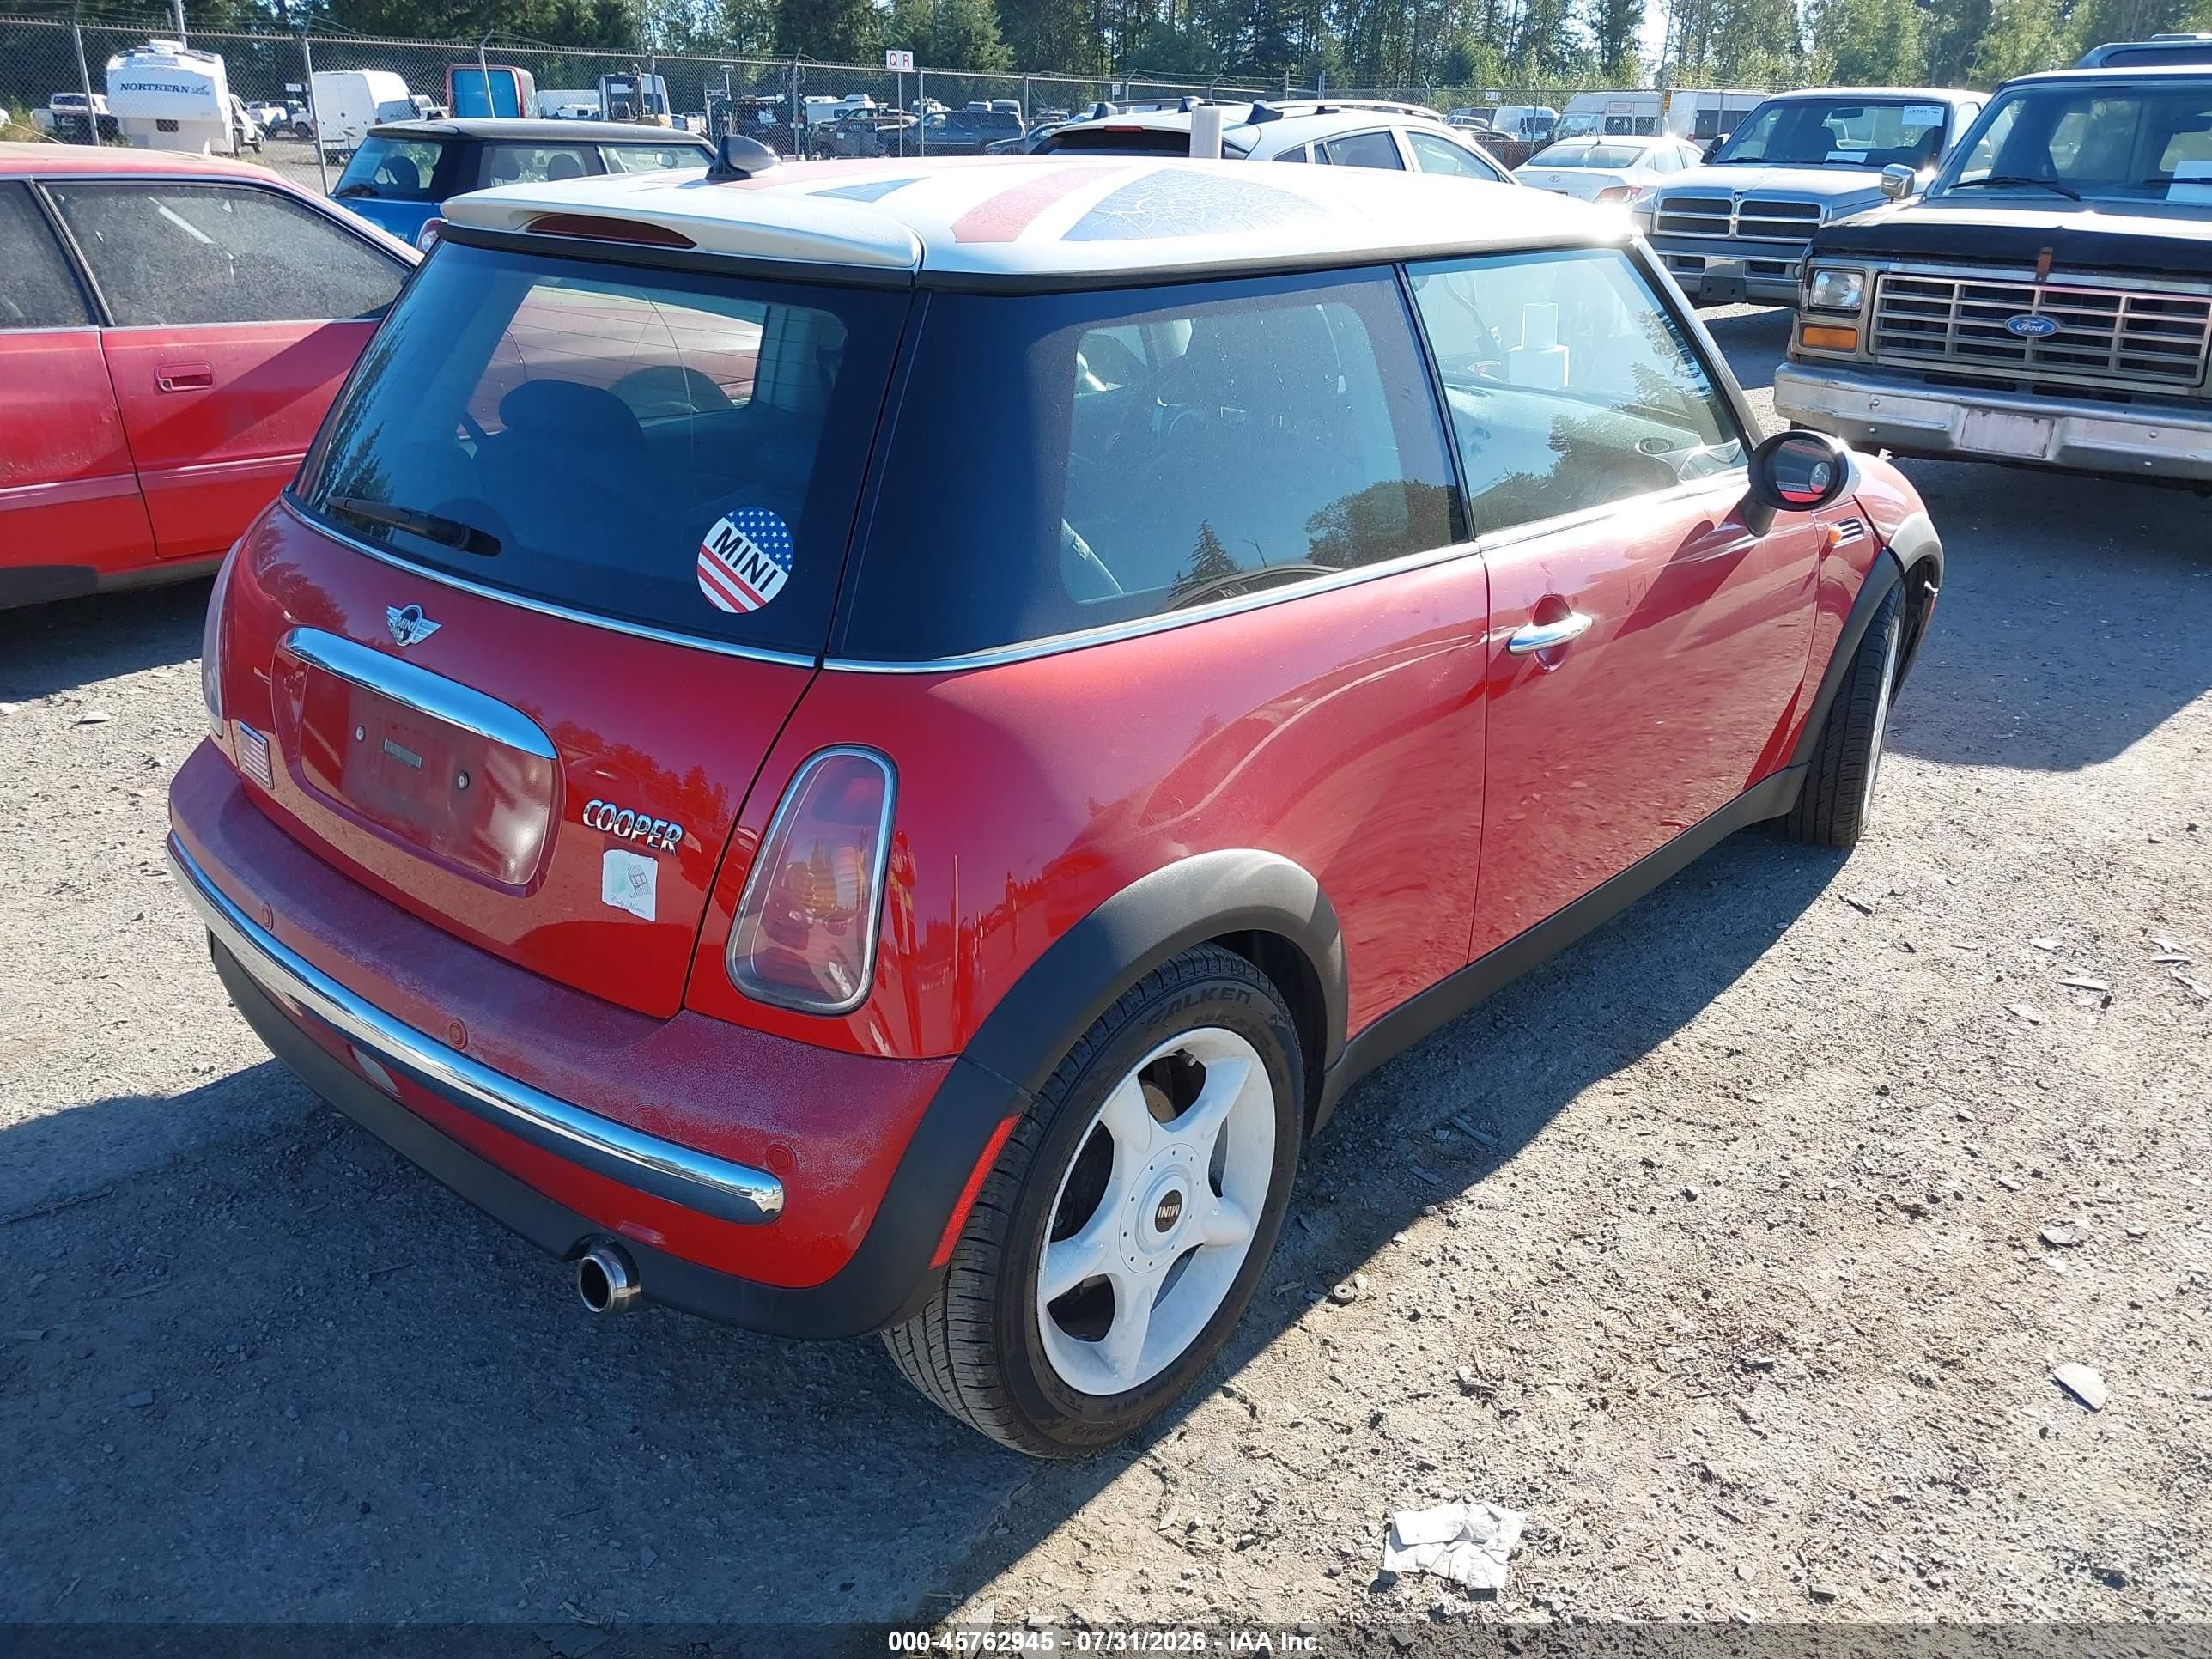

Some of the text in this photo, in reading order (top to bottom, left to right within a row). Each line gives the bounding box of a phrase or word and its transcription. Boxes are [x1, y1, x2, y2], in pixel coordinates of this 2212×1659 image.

[889, 52, 910, 67] Q R
[120, 82, 190, 94] NORTHERN
[2015, 319, 2045, 332] Ford
[711, 526, 779, 593] MINI
[396, 616, 417, 633] MINI
[582, 799, 684, 857] COOPER
[1147, 988, 1253, 1030] FALKEN
[1157, 1203, 1181, 1218] MINI
